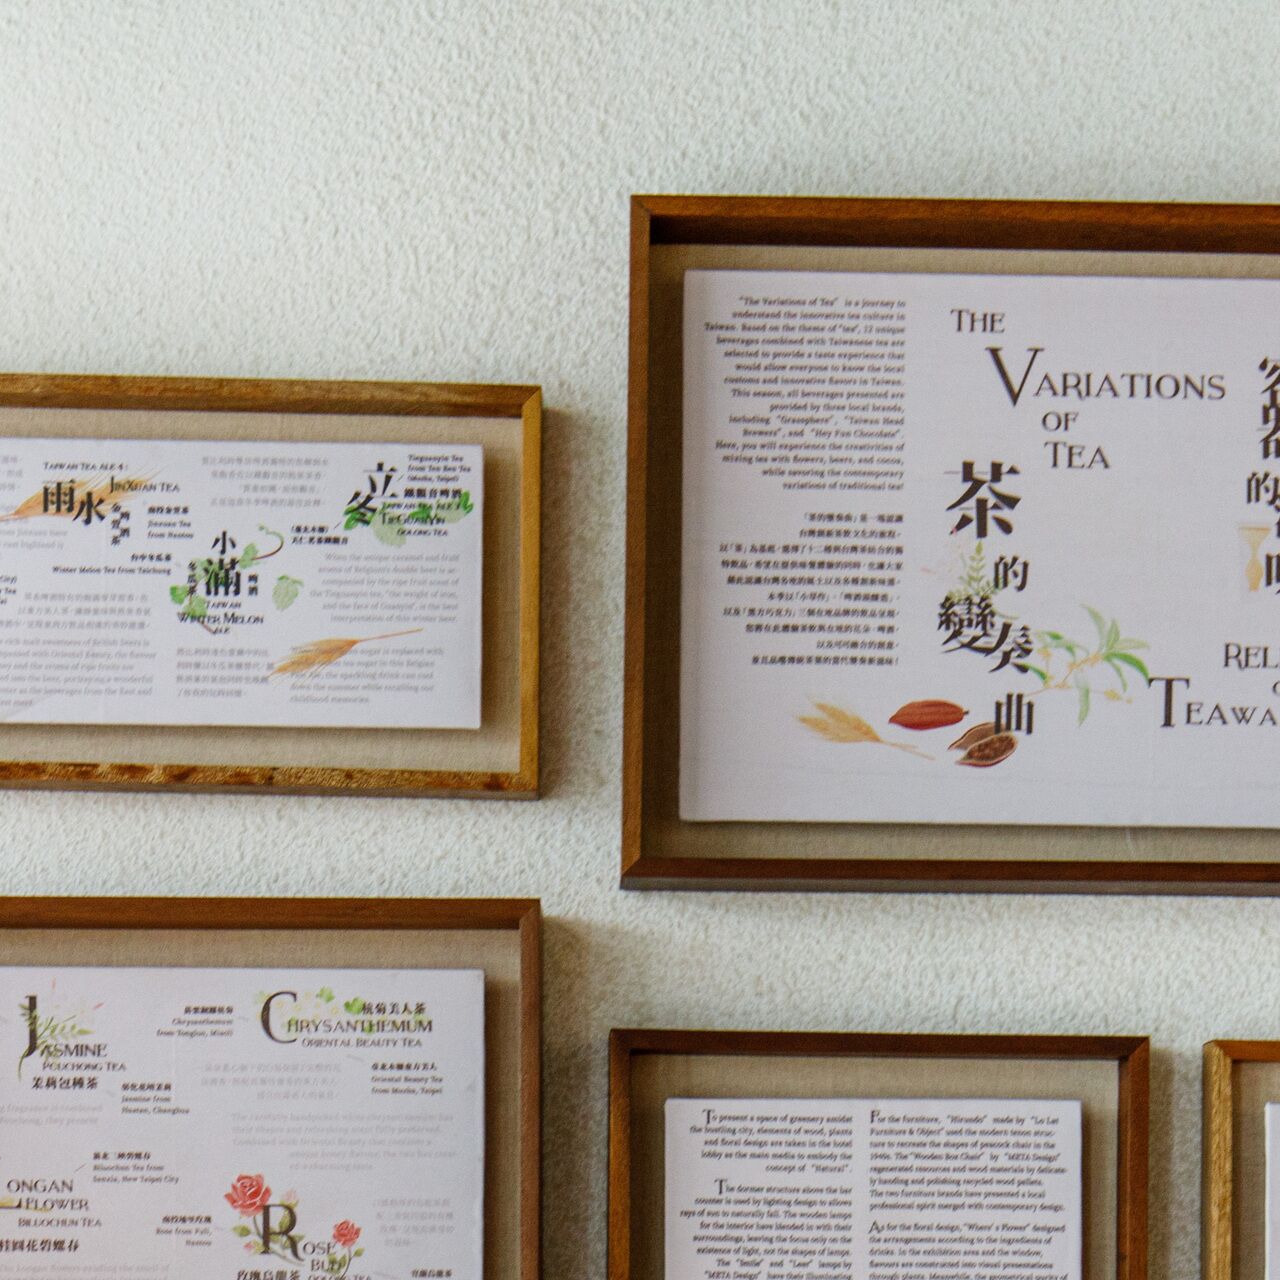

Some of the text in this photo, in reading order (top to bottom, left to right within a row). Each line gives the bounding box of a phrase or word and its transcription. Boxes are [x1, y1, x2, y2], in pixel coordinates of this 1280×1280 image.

[951, 309, 1005, 332] THE
[985, 347, 1225, 406] VARIATIONS
[1042, 411, 1079, 432] OF
[1044, 441, 1111, 469] TEA
[160, 482, 180, 492] TEA
[42, 479, 105, 525] 雨水
[21, 995, 108, 1058] JASMINE
[260, 990, 433, 1044] CHRYSANTHEMUM
[402, 1037, 423, 1048] TEA
[106, 1062, 127, 1072] TEA
[20, 1198, 89, 1211] FLOWER
